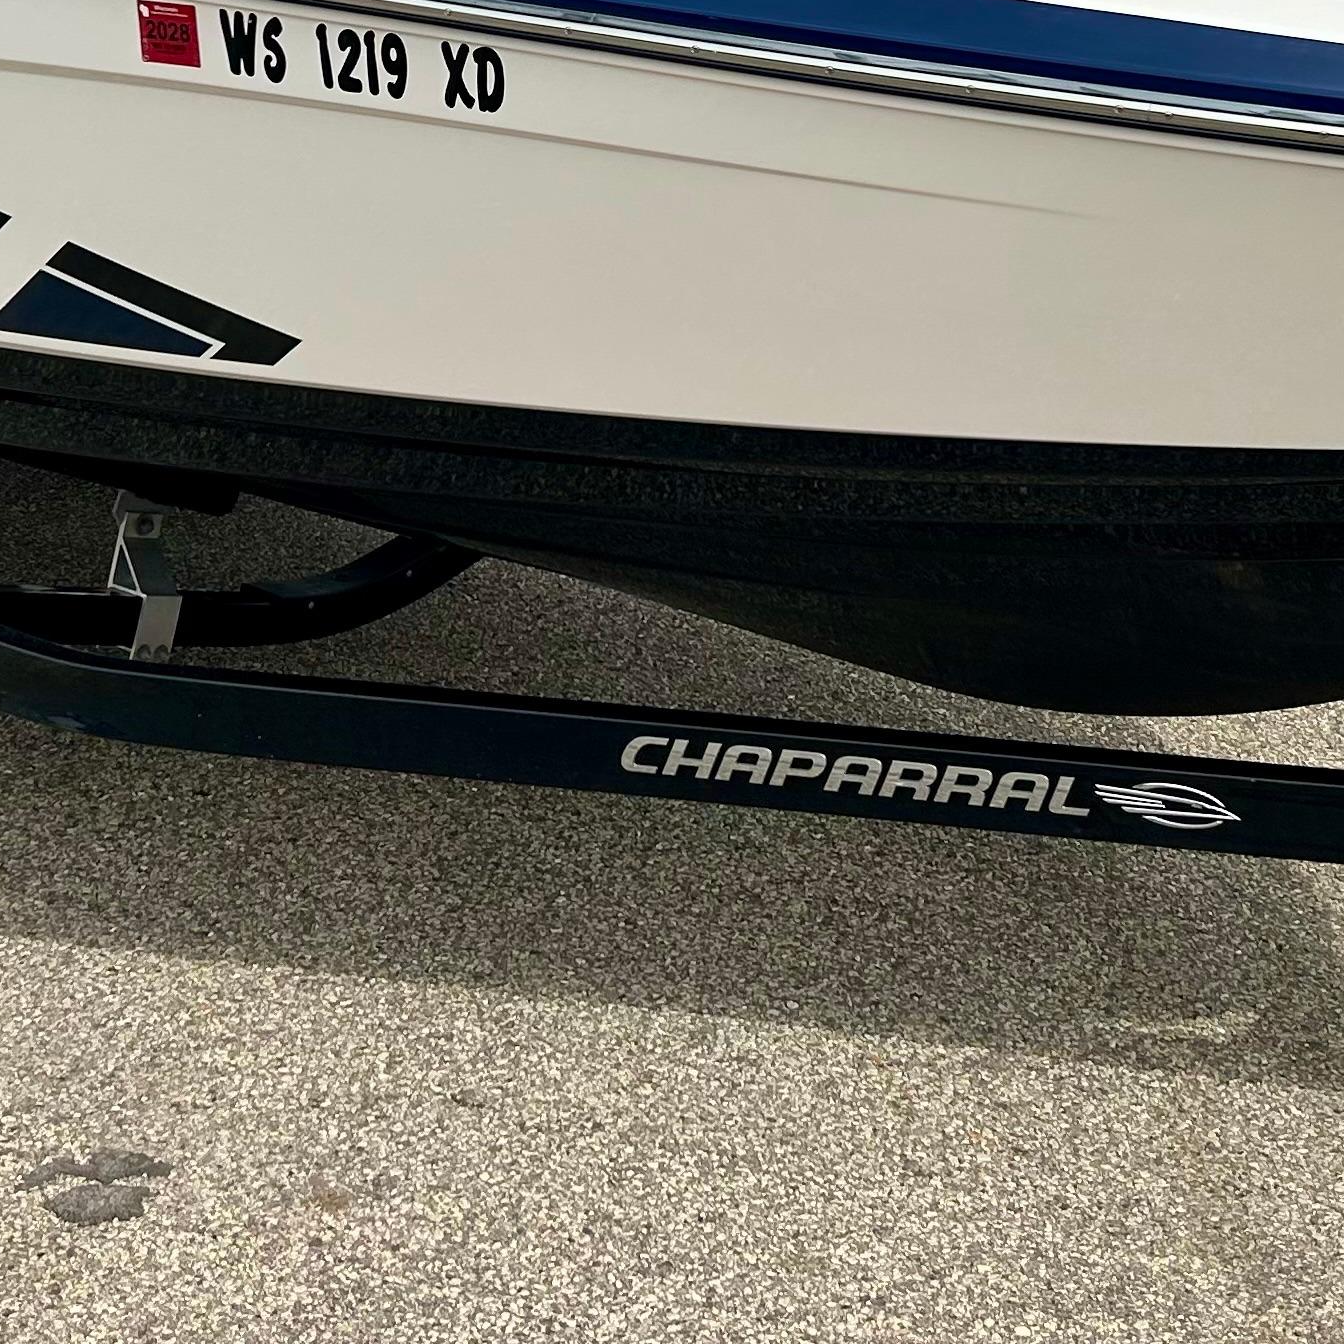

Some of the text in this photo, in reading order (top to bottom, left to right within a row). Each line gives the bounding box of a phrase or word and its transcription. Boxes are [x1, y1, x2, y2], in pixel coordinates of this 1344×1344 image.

[219, 8, 505, 114] WS 1219 XD
[620, 735, 1091, 817] CHAPARRAL
